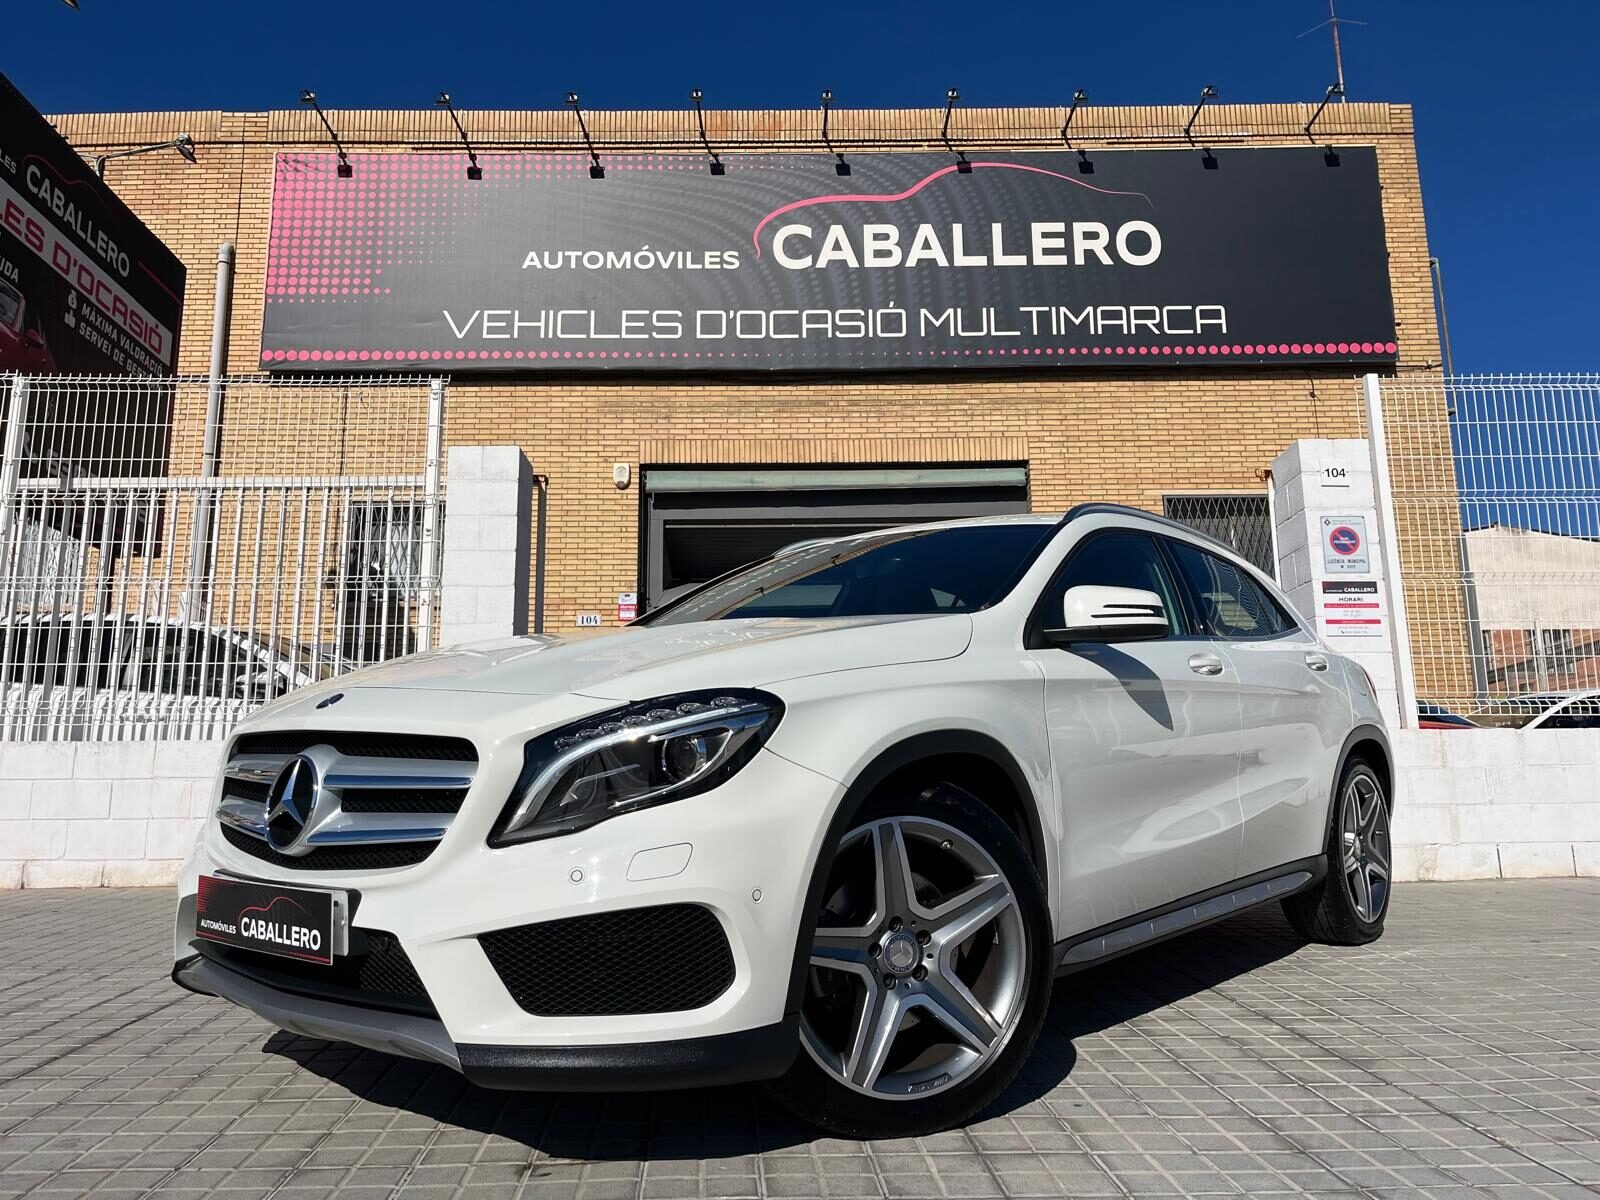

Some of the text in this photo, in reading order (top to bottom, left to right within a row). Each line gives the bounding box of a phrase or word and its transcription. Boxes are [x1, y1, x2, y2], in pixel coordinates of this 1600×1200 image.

[26, 164, 130, 277] CABALLERO
[522, 221, 1161, 270] AUTOMÓVILES CABALLERO
[0, 197, 162, 354] ES D'OCASIÓ
[443, 300, 1227, 340] VEHICLES D'OCASIÓ MULTIMARCA
[79, 321, 112, 356] SERVEI
[113, 348, 126, 366] DE
[120, 334, 163, 376] VALORACIÓ
[1324, 467, 1346, 478] 104
[581, 615, 597, 625] 104
[200, 916, 322, 951] AUTOMÓVILES CABALLERO
